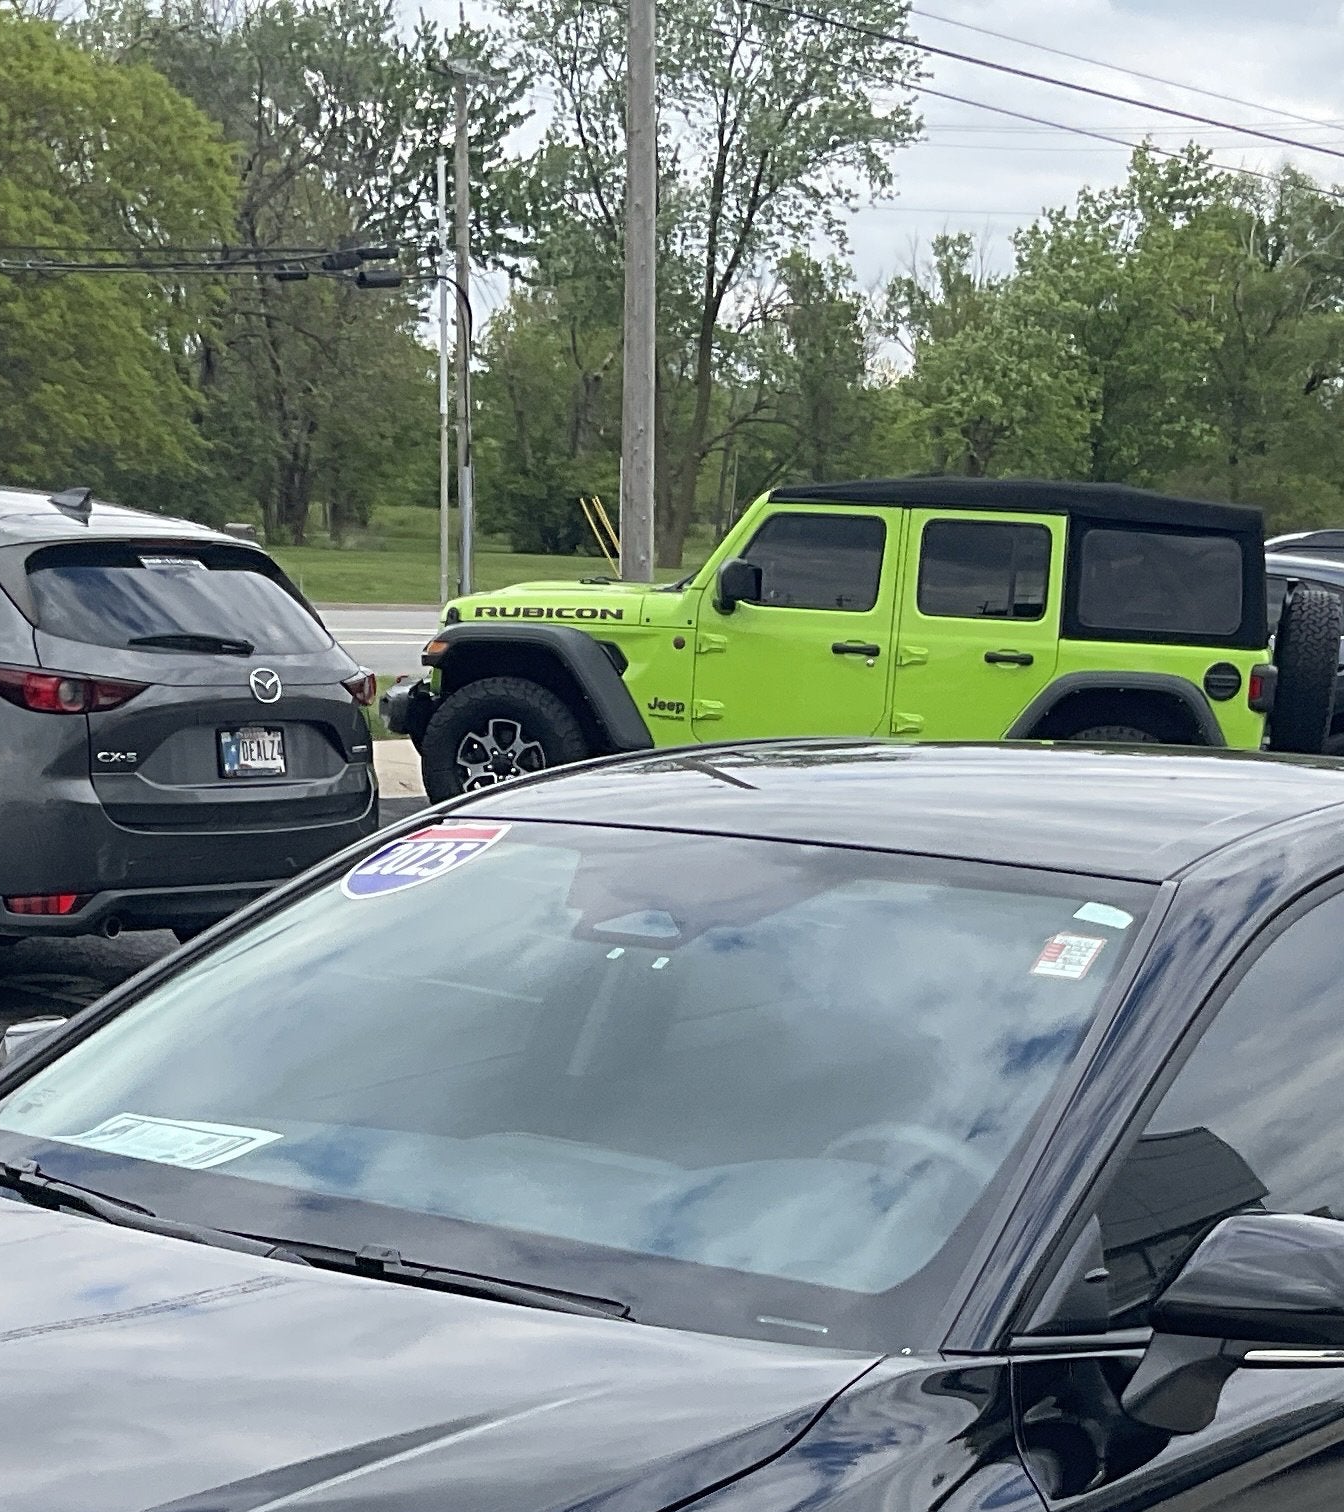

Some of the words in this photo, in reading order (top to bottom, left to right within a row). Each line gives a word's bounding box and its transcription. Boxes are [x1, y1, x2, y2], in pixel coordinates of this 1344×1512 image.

[474, 606, 624, 620] RUBICON
[647, 696, 685, 714] Jeep
[97, 751, 137, 762] CX-5
[355, 842, 481, 877] 2025
